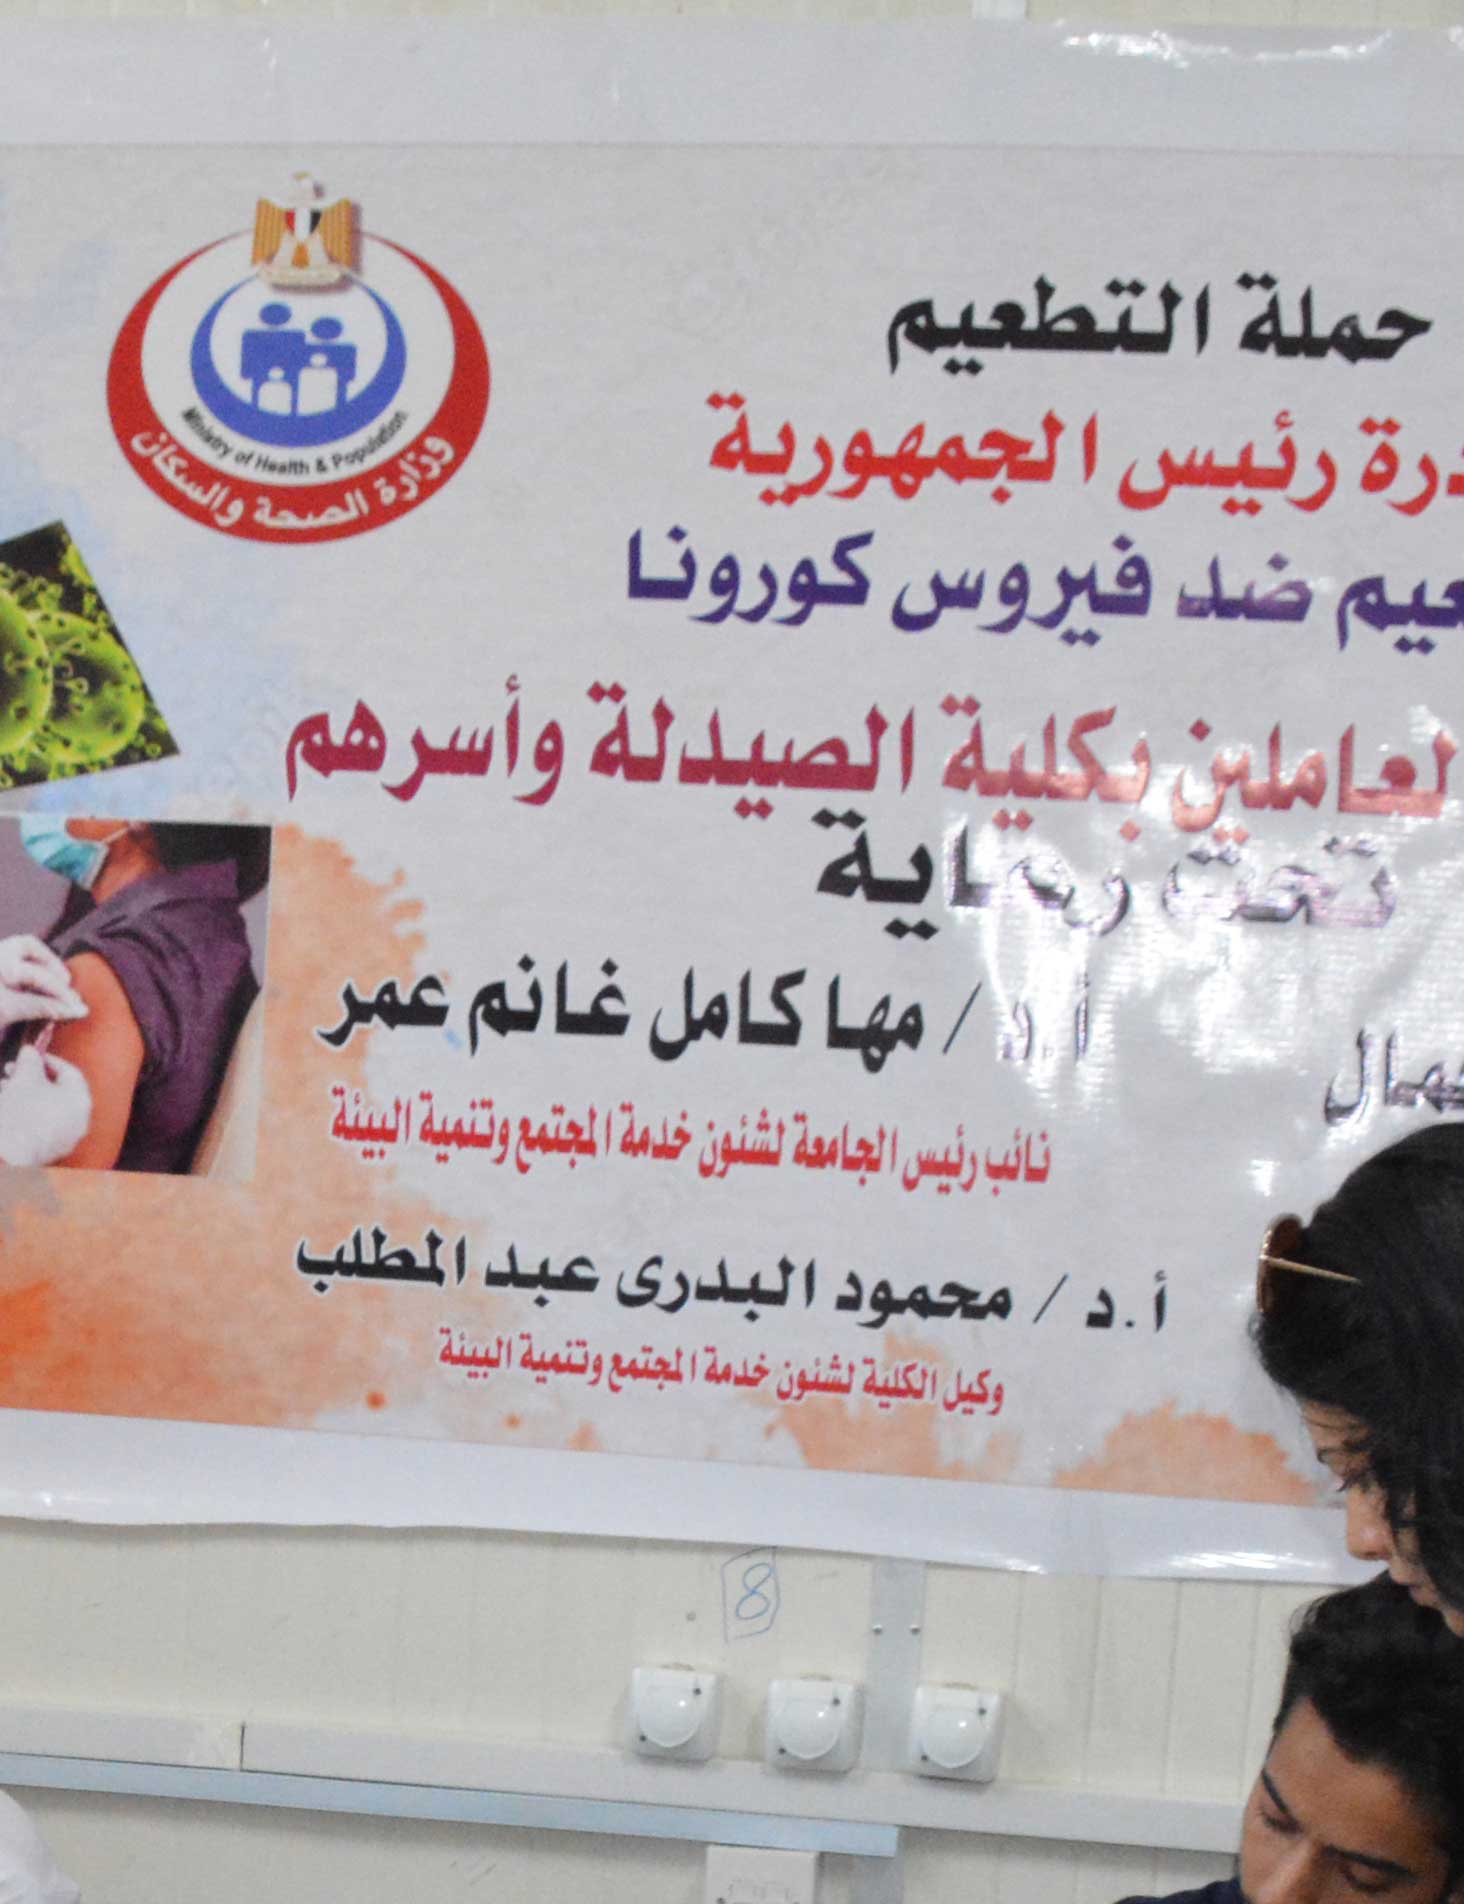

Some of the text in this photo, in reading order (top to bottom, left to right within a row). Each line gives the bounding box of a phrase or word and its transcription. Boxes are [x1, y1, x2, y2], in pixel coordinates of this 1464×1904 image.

[887, 272, 1433, 376] حملة التطعيم
[181, 406, 410, 476] Ministry of Health & Population
[706, 392, 1097, 507] الجمهورية
[1118, 410, 1337, 517] رئيس
[130, 428, 457, 530] وزارة الصحة والسكان
[628, 525, 874, 627] كورونا
[891, 534, 1152, 647] فيروس
[1176, 553, 1313, 623] ضد
[286, 674, 564, 806] وأسرهم
[587, 681, 914, 821] الصيدلة
[940, 694, 1152, 840] بكلية
[315, 973, 449, 1047] عمر
[468, 954, 631, 1056] غانم
[649, 967, 807, 1062] كامل
[826, 974, 924, 1074] مها
[332, 1087, 411, 1159] البيئة
[419, 1091, 510, 1165] وتنمية
[515, 1105, 611, 1174] المجتمع
[620, 1102, 692, 1160] خدمة
[792, 1112, 897, 1173] الجامعة
[902, 1125, 978, 1194] رئيس
[985, 1129, 1050, 1196] نائب
[297, 1218, 466, 1292] المطلب
[485, 1244, 600, 1308] عبد
[835, 1271, 1013, 1329] محمود
[440, 1328, 512, 1379] البيئة
[519, 1333, 603, 1386] وتنمية
[608, 1346, 696, 1393] المجتمع
[704, 1346, 770, 1387] خدمة
[863, 1358, 936, 1409] الكلية
[943, 1370, 1004, 1416] وكيل
[735, 1561, 776, 1621] 8
